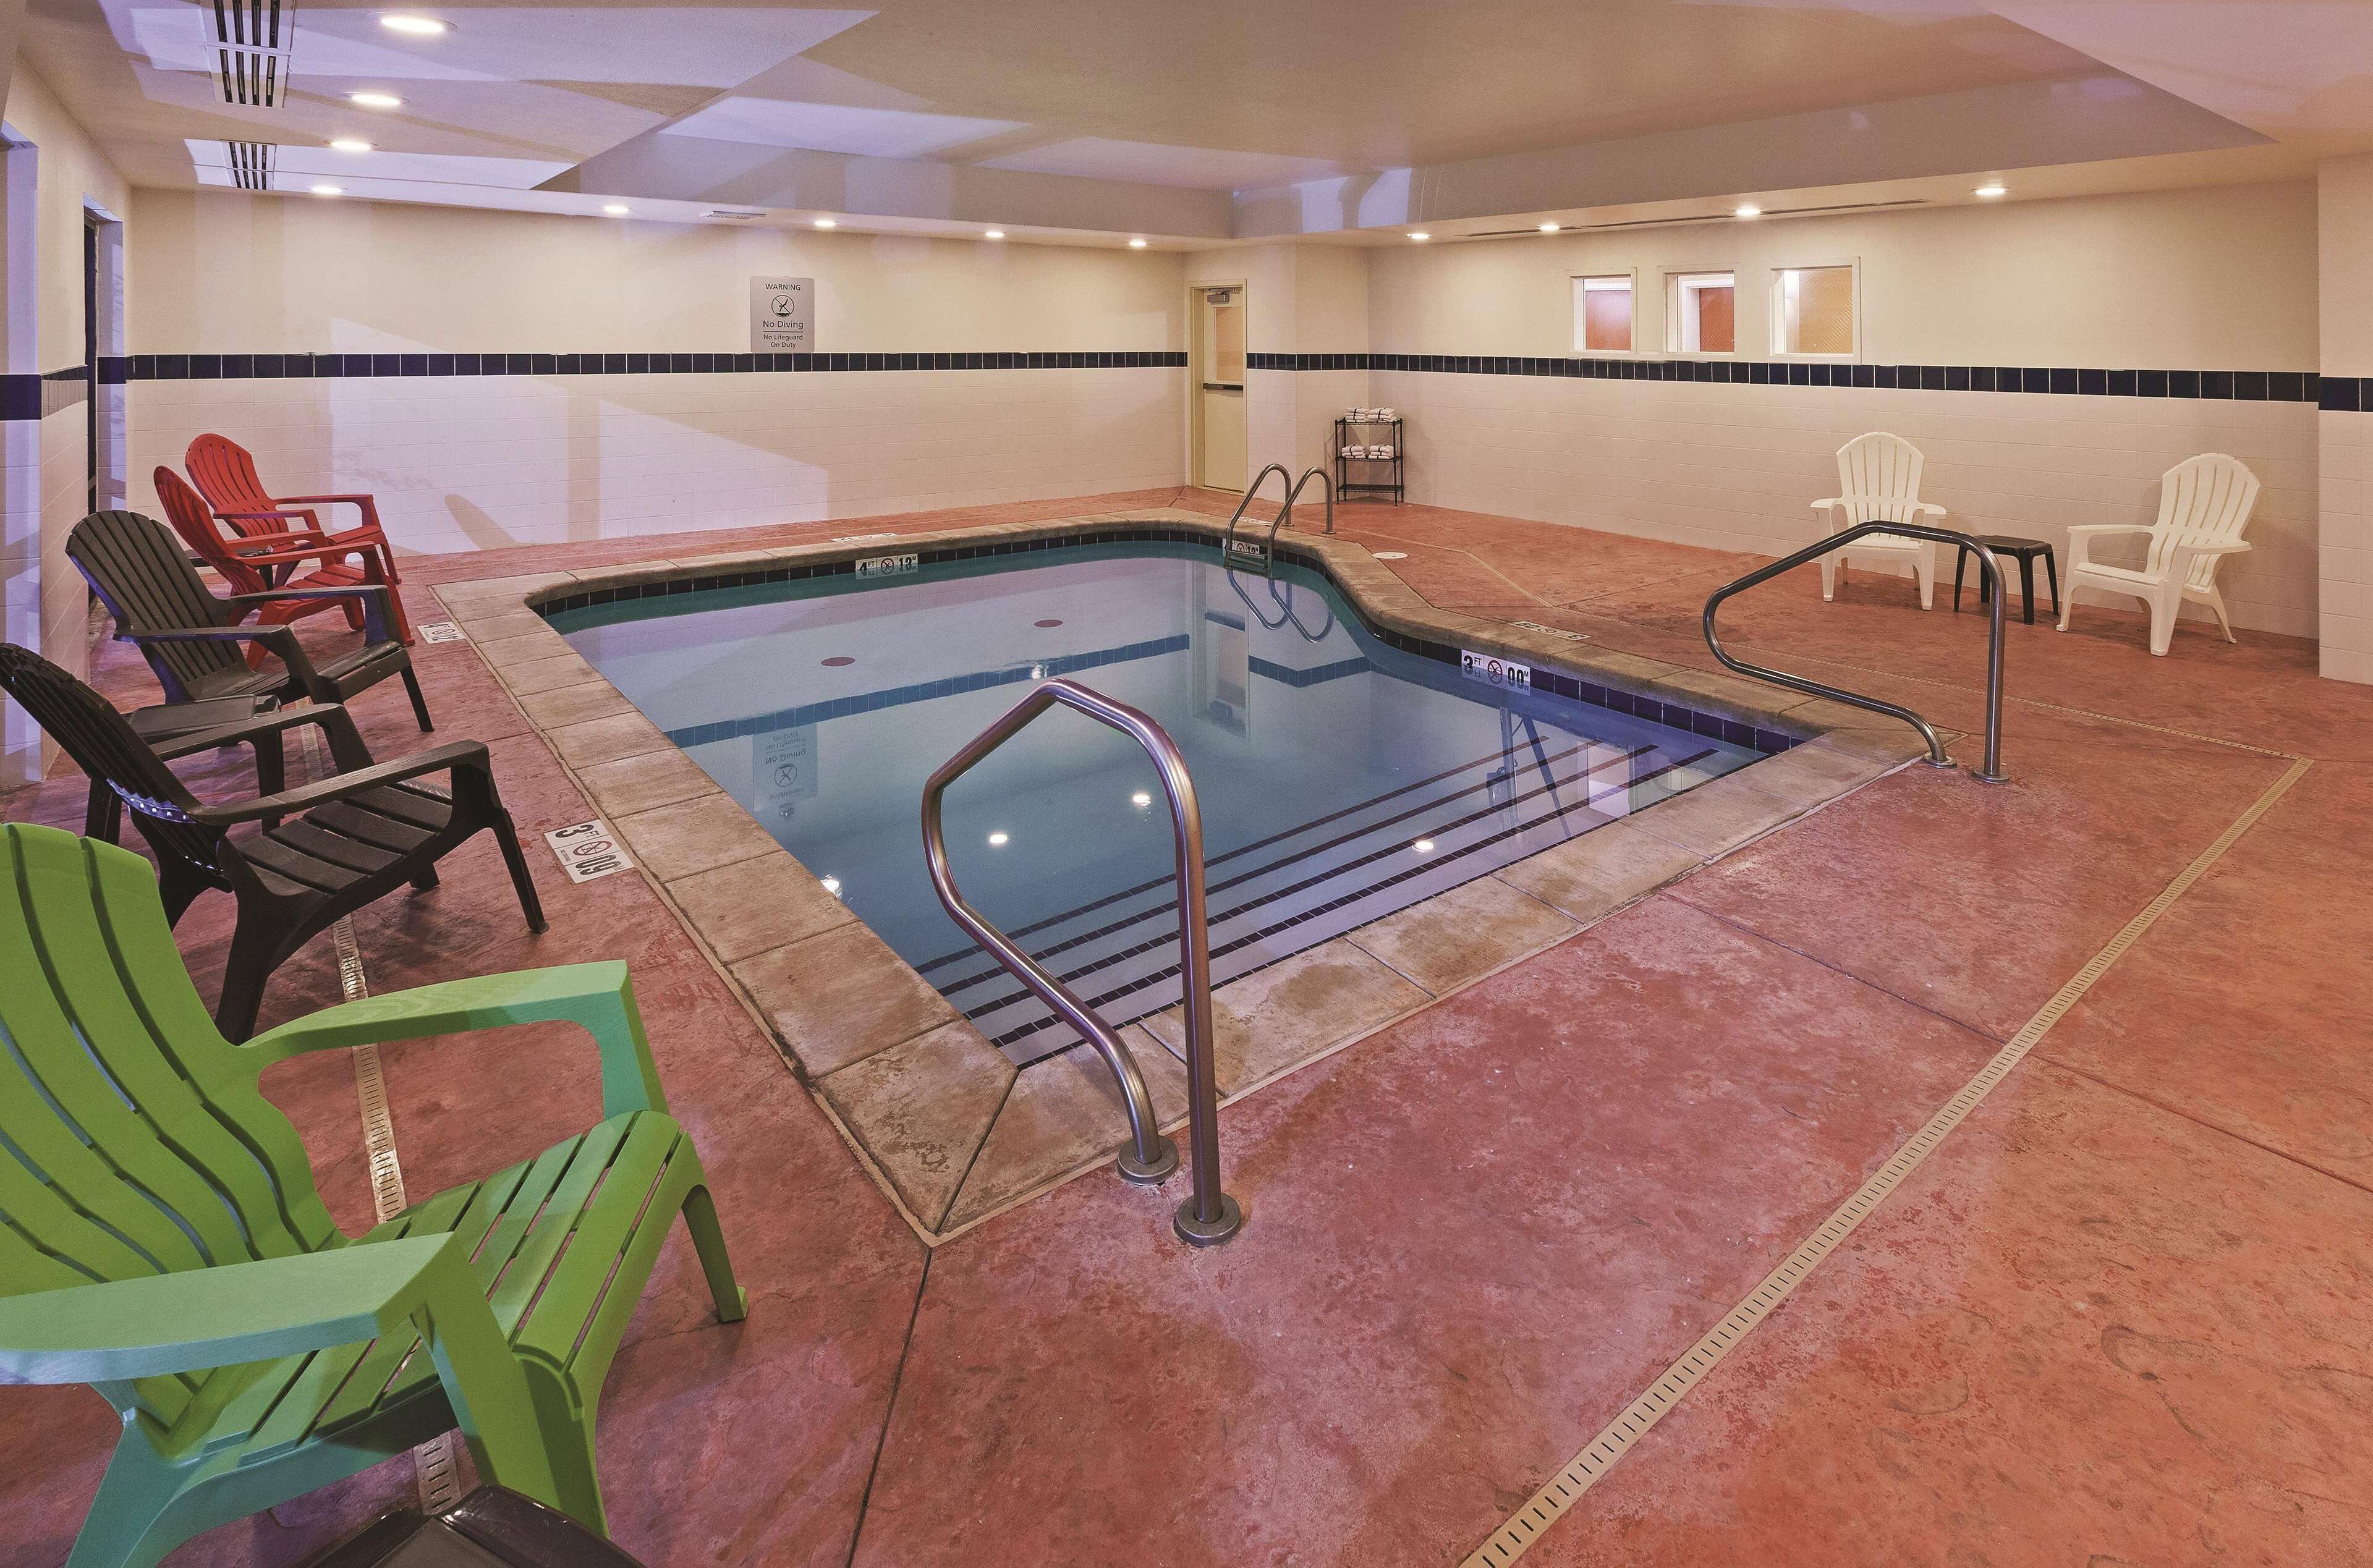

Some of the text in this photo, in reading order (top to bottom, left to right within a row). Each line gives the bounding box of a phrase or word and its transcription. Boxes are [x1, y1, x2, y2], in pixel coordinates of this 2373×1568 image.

[765, 283, 800, 291] WARNING
[777, 320, 804, 329] Diving
[1474, 657, 1482, 666] FT
[555, 824, 600, 838] 3 FT
[575, 855, 622, 876] 0.9
